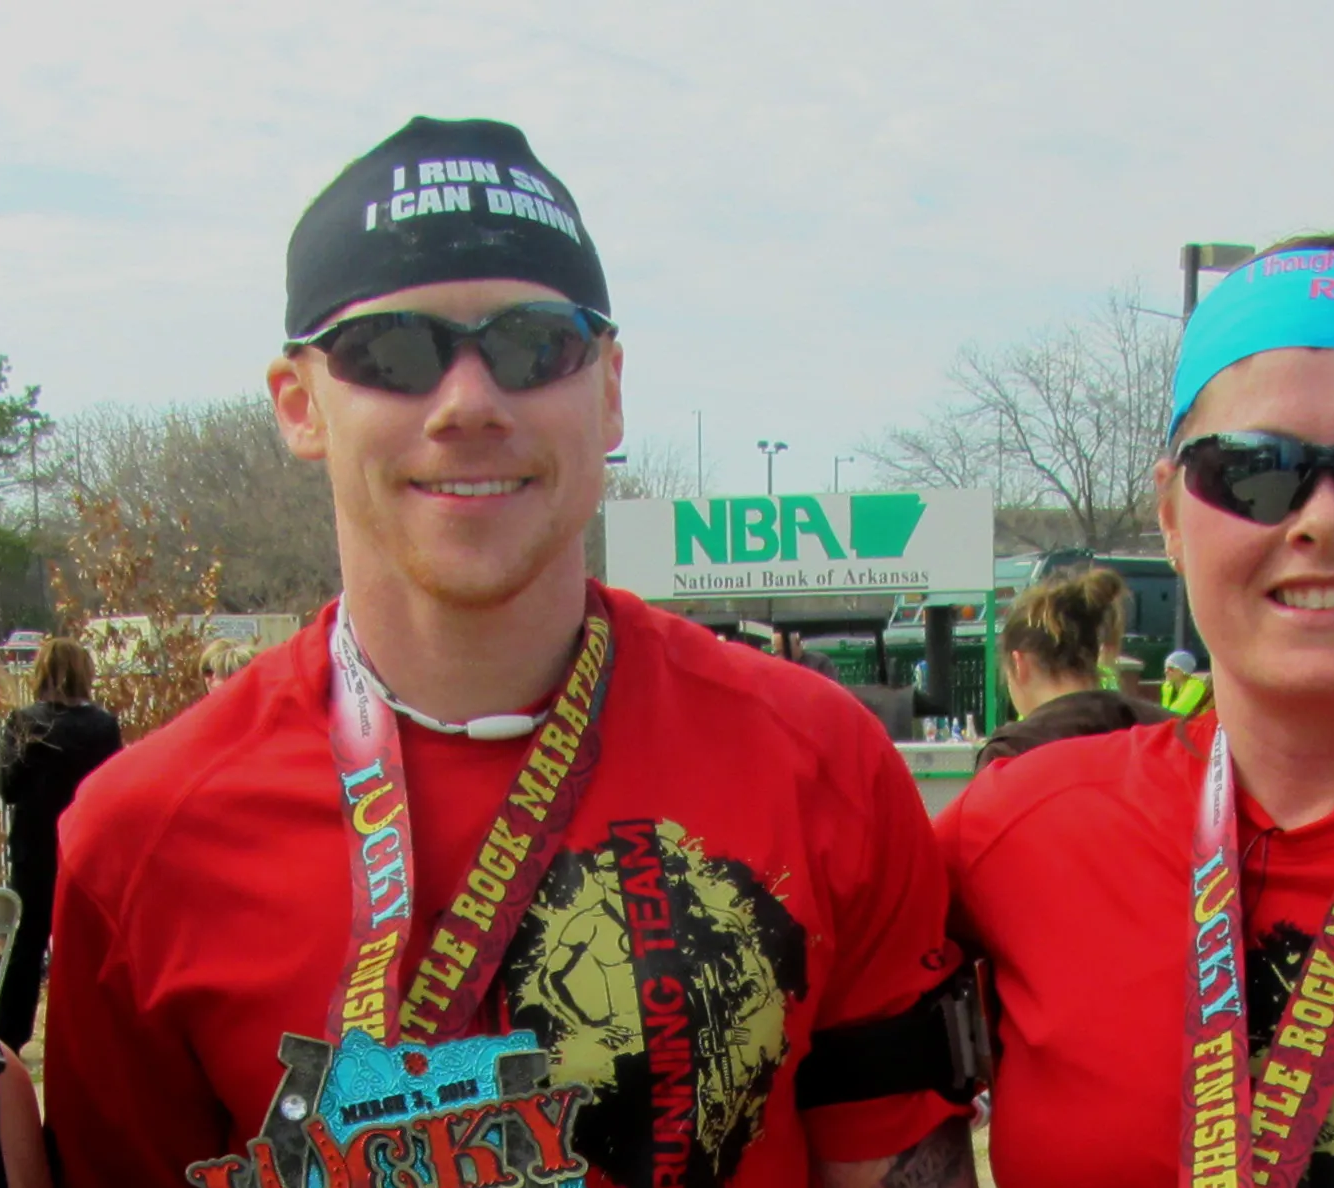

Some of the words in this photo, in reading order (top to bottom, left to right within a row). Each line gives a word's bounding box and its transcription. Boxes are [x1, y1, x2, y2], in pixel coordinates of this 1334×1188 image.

[366, 202, 378, 232] I
[391, 186, 471, 222] CAN
[394, 166, 405, 192] I
[418, 160, 500, 186] RUN
[673, 495, 847, 566] NBA
[673, 571, 752, 591] National
[762, 570, 808, 588] Bank
[816, 568, 835, 586] of
[843, 568, 929, 586] Arkansas
[340, 758, 411, 929] LUCKY
[399, 928, 478, 1045] TTLE
[451, 817, 532, 933] ROCK
[509, 616, 609, 822] MARATHON
[627, 829, 675, 959] TEAM
[1193, 846, 1242, 1026] LUCKY
[341, 931, 399, 1046] FINISH
